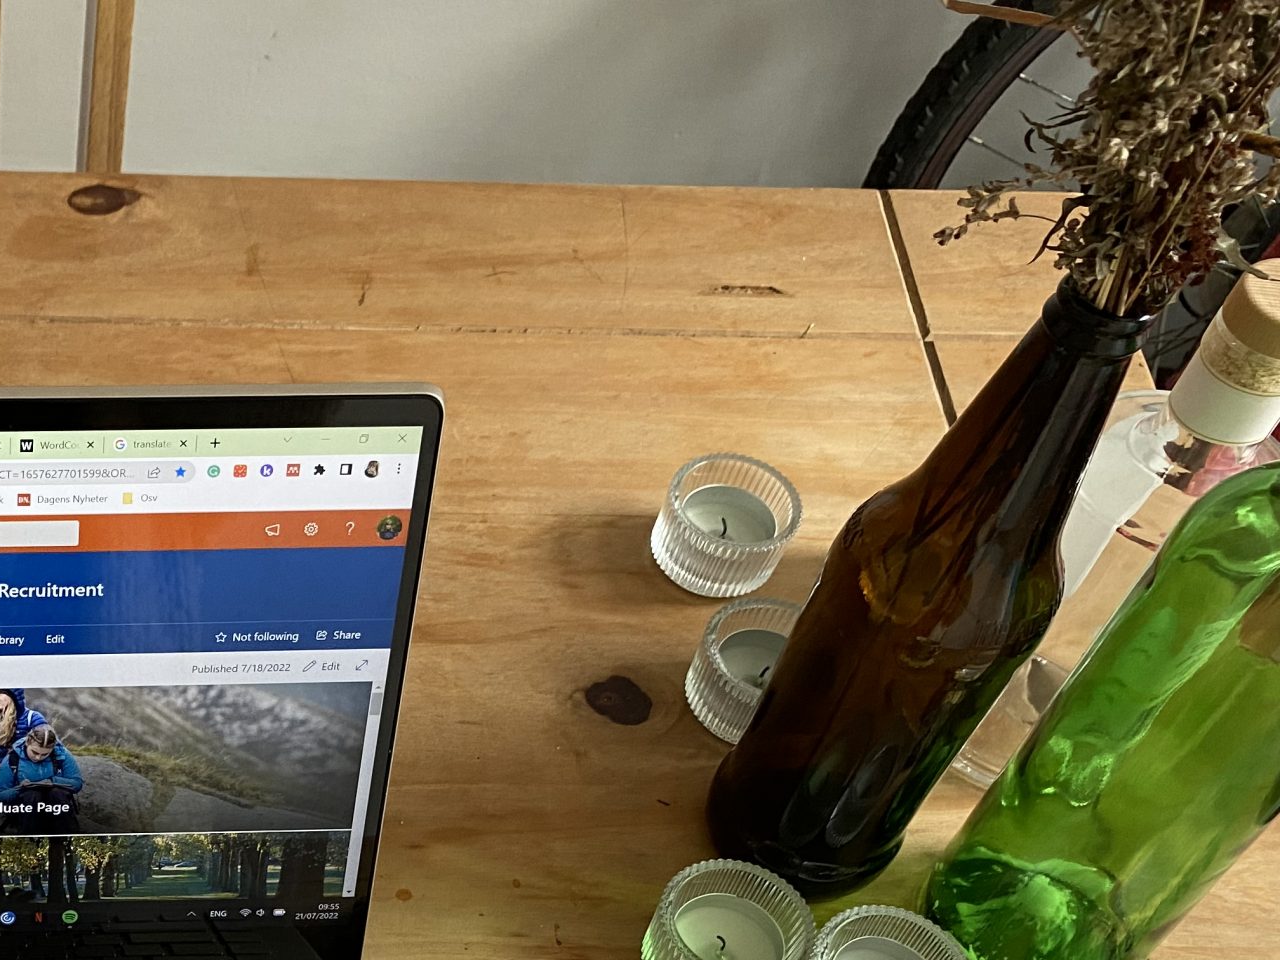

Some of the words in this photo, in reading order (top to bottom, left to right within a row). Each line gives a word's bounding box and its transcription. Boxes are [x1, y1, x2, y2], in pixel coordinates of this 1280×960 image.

[37, 494, 70, 506] Dagens
[72, 494, 108, 505] Nyheter
[141, 494, 158, 502] Osv
[46, 634, 65, 645] Edit
[232, 632, 252, 643] Not
[254, 630, 300, 644] following
[332, 630, 361, 641] Share
[191, 663, 238, 674] Published
[241, 662, 292, 674] 7/18/2022
[321, 661, 340, 672] Edit
[36, 800, 70, 817] Page
[210, 910, 227, 918] ENG
[295, 912, 339, 920] 21/07/2022
